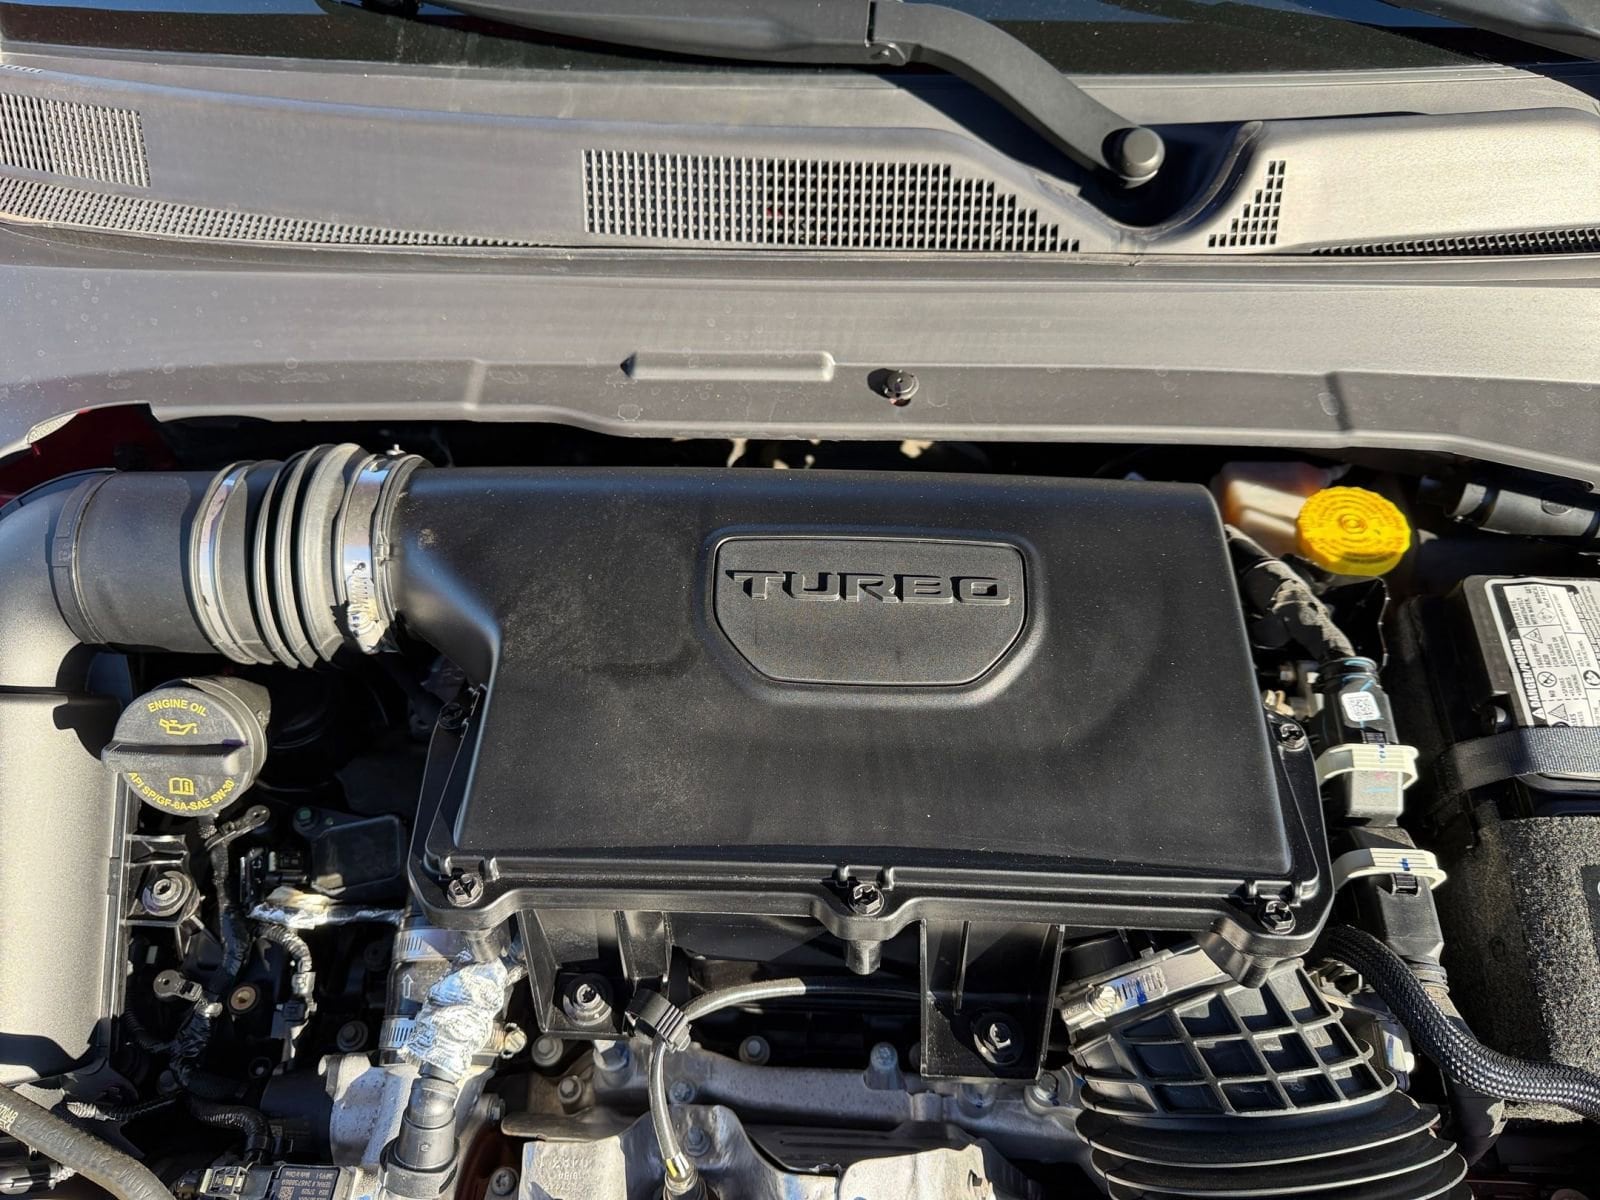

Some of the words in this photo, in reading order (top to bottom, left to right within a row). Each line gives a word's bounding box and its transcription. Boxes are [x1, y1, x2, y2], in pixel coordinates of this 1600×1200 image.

[725, 570, 1010, 606] TURBO
[1510, 638, 1541, 707] DANGER/POISON
[1541, 654, 1551, 665] ACID
[148, 699, 188, 712] ENGINE
[190, 702, 207, 717] OIL
[128, 772, 144, 788] API
[211, 777, 235, 804] 5W-30
